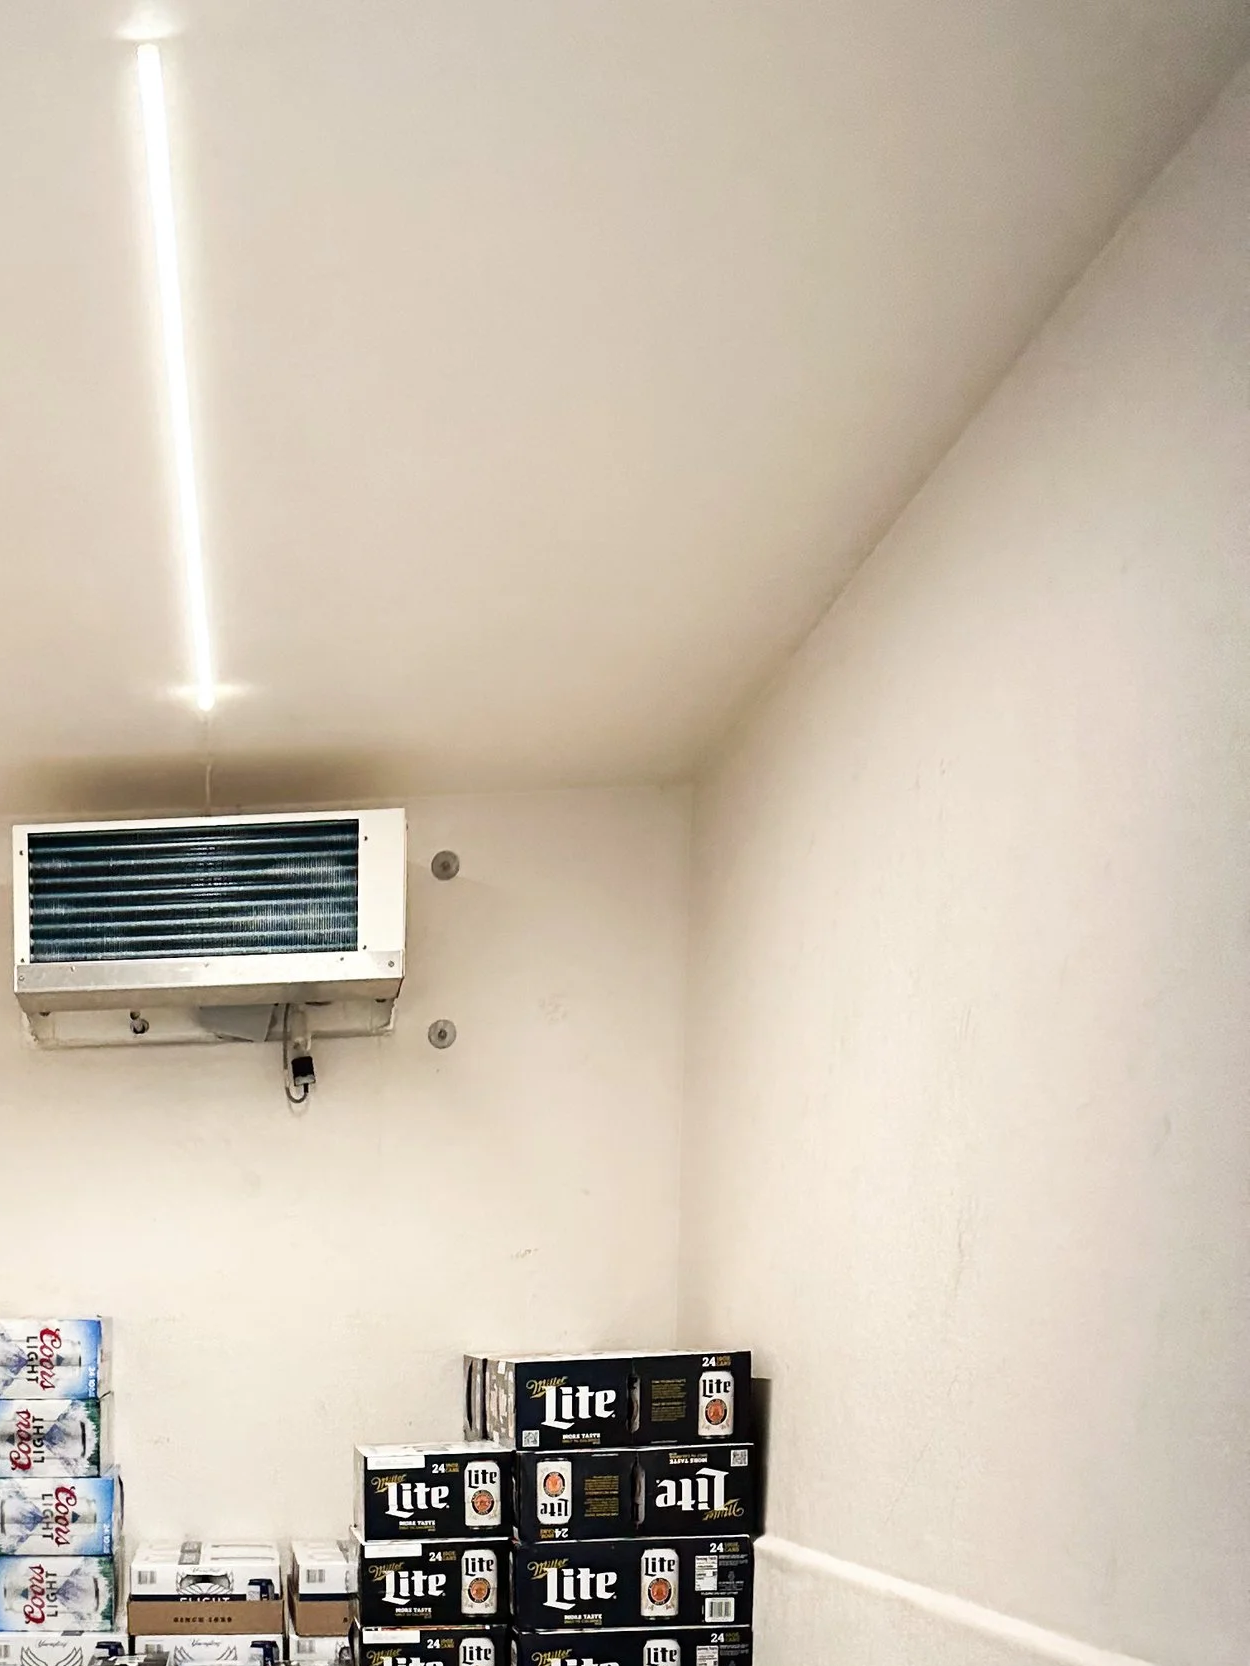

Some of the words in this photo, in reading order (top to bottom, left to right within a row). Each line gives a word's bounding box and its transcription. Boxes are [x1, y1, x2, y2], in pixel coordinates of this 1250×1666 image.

[26, 1336, 38, 1383] LIGHT
[40, 1328, 61, 1390] Coors
[702, 1357, 715, 1367] 24
[702, 1378, 731, 1398] Lite
[541, 1386, 616, 1429] Lite
[10, 1408, 31, 1471] Coors
[33, 1416, 45, 1463] LIGHT
[432, 1464, 445, 1473] 24
[468, 1469, 497, 1488] Lite
[655, 1467, 729, 1511] Lite
[385, 1483, 449, 1518] Lite
[540, 1499, 569, 1517] Lite
[42, 1494, 53, 1540] LIGHT
[55, 1486, 77, 1547] Coors
[555, 1528, 568, 1538] 24
[429, 1552, 442, 1561] 24
[710, 1543, 724, 1553] 24
[465, 1557, 494, 1576] Lite
[527, 1559, 568, 1580] Miller
[644, 1557, 675, 1578] Lite
[23, 1564, 45, 1624] Coors
[46, 1571, 58, 1617] LIGHT
[382, 1570, 446, 1605] Lite
[543, 1568, 617, 1610] Lite
[427, 1639, 440, 1649] 24
[710, 1633, 724, 1643] 24
[462, 1646, 492, 1665] Lite
[646, 1647, 678, 1666] Lite
